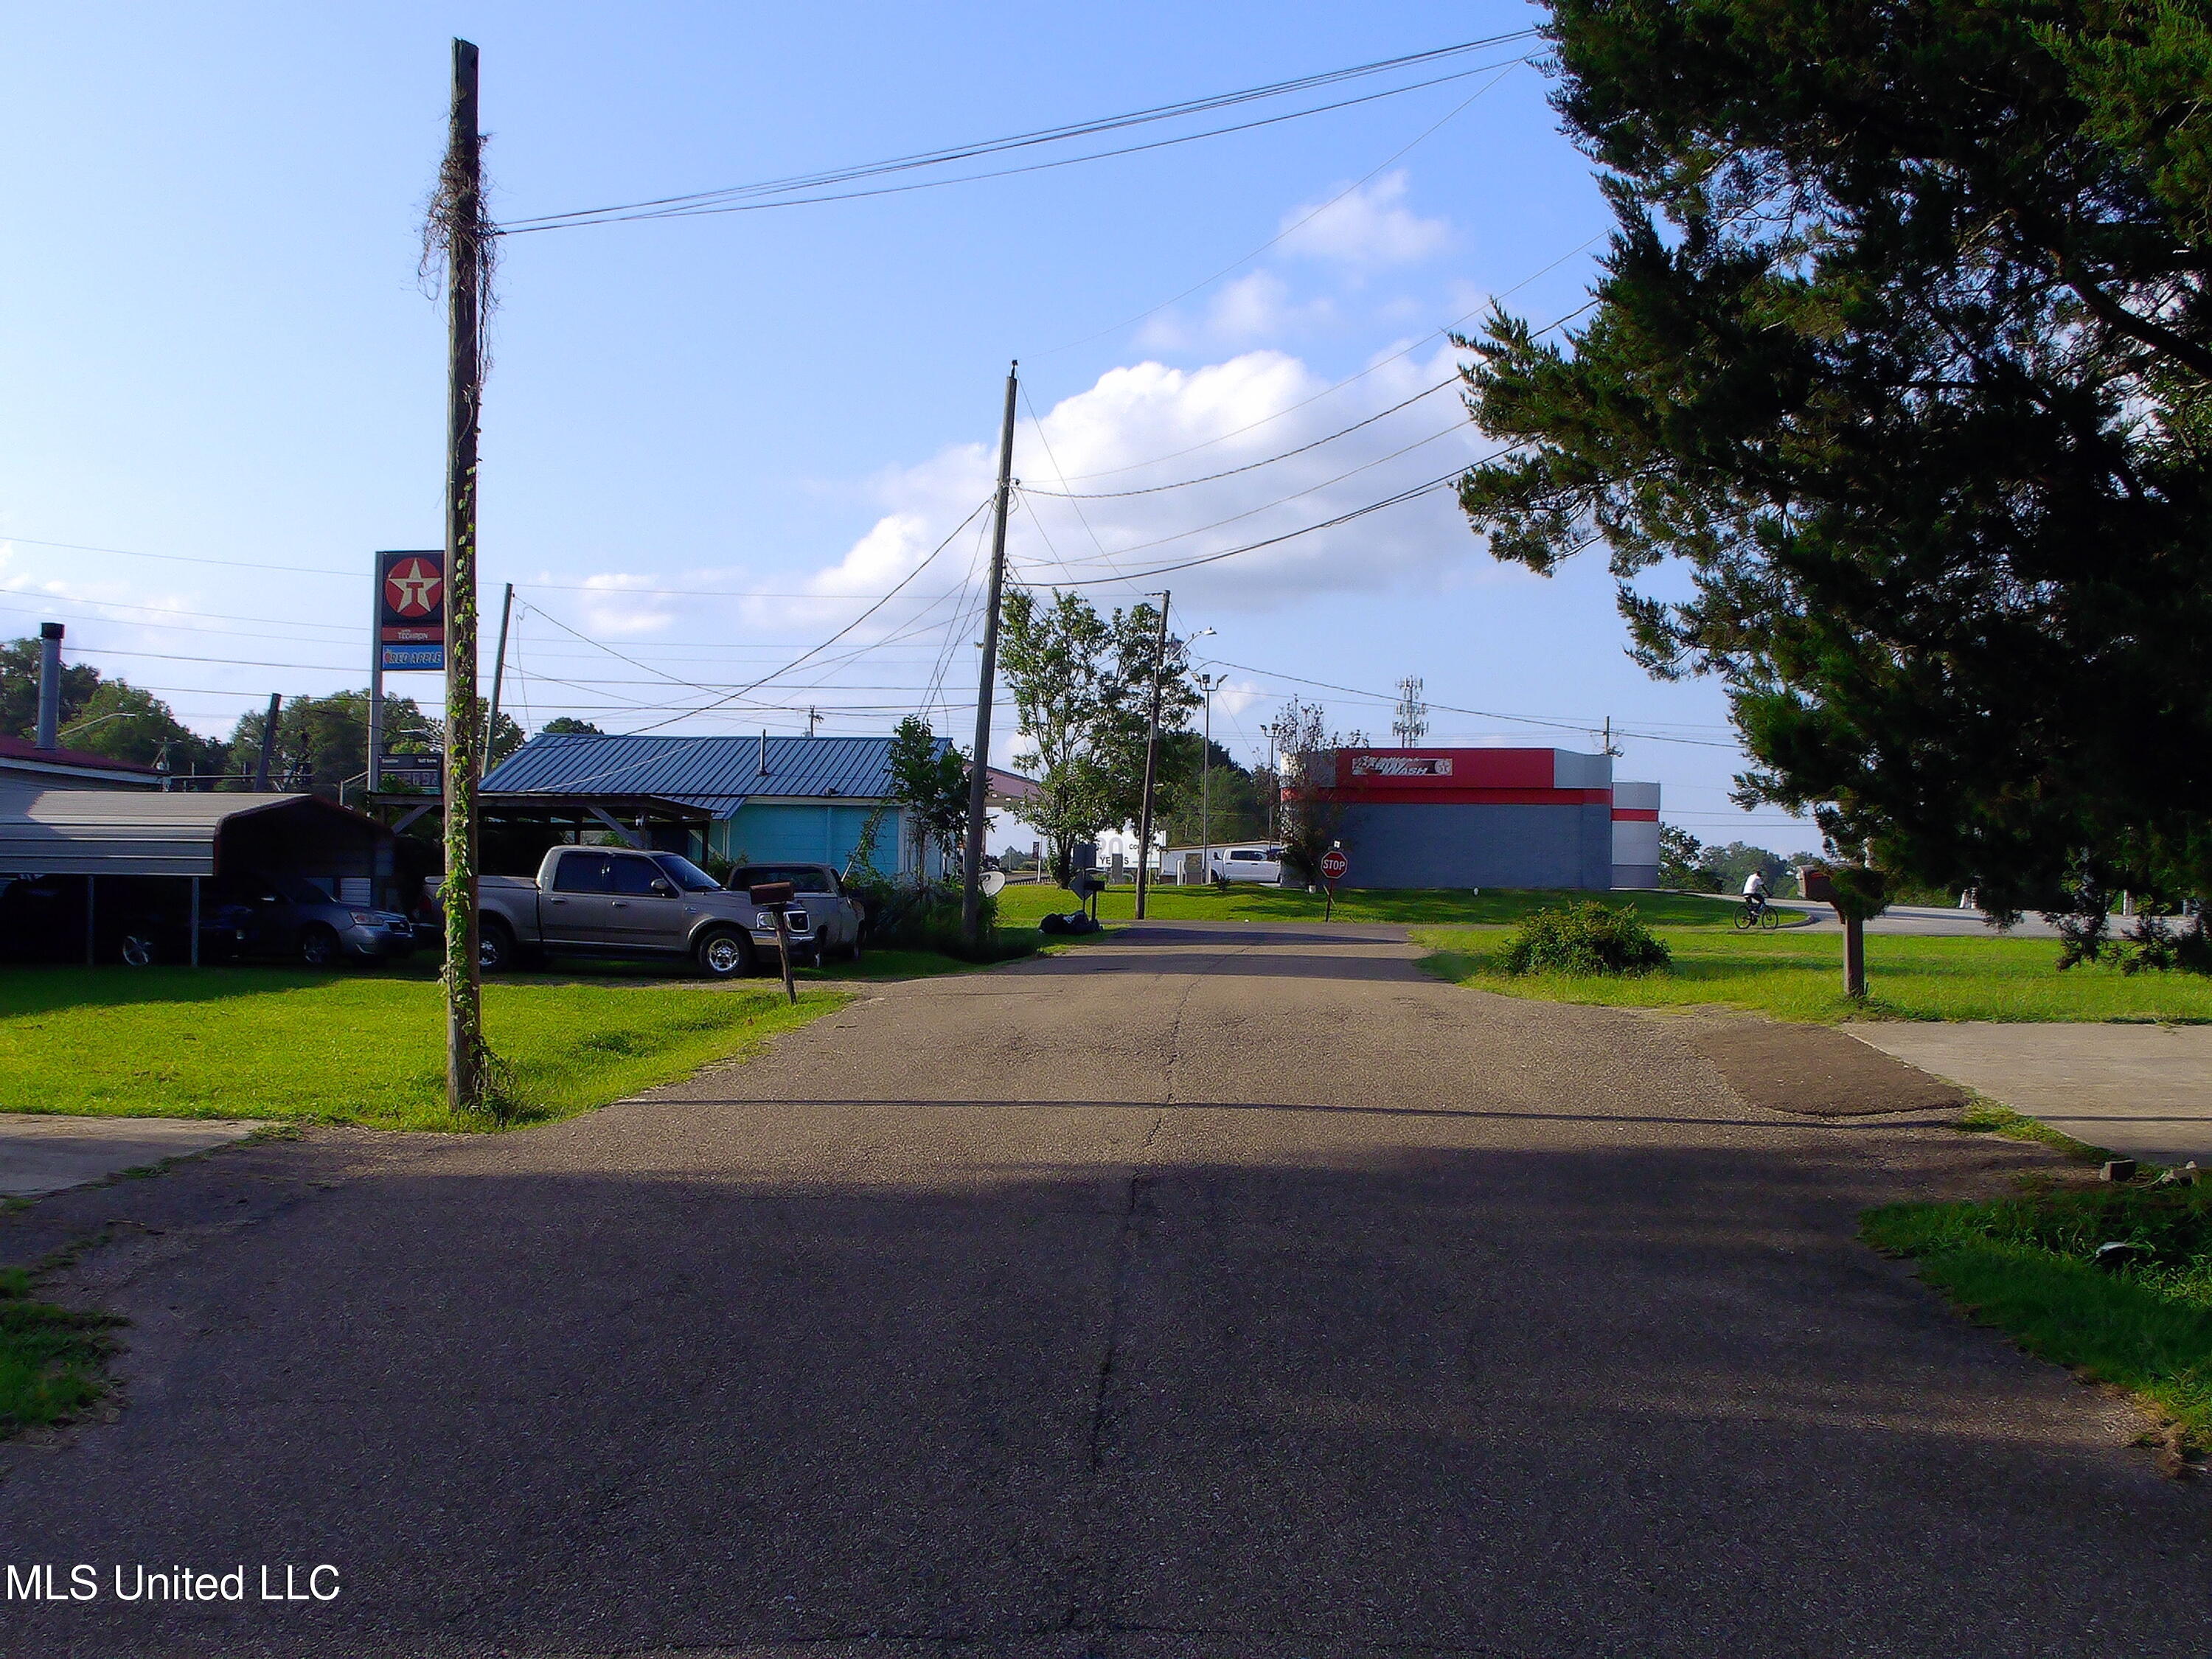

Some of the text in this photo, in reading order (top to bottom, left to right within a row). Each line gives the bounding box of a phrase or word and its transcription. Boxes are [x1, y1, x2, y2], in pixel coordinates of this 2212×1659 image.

[389, 652, 442, 664] RED APPLE
[1099, 856, 1130, 865] YES
[1323, 859, 1346, 871] STOP
